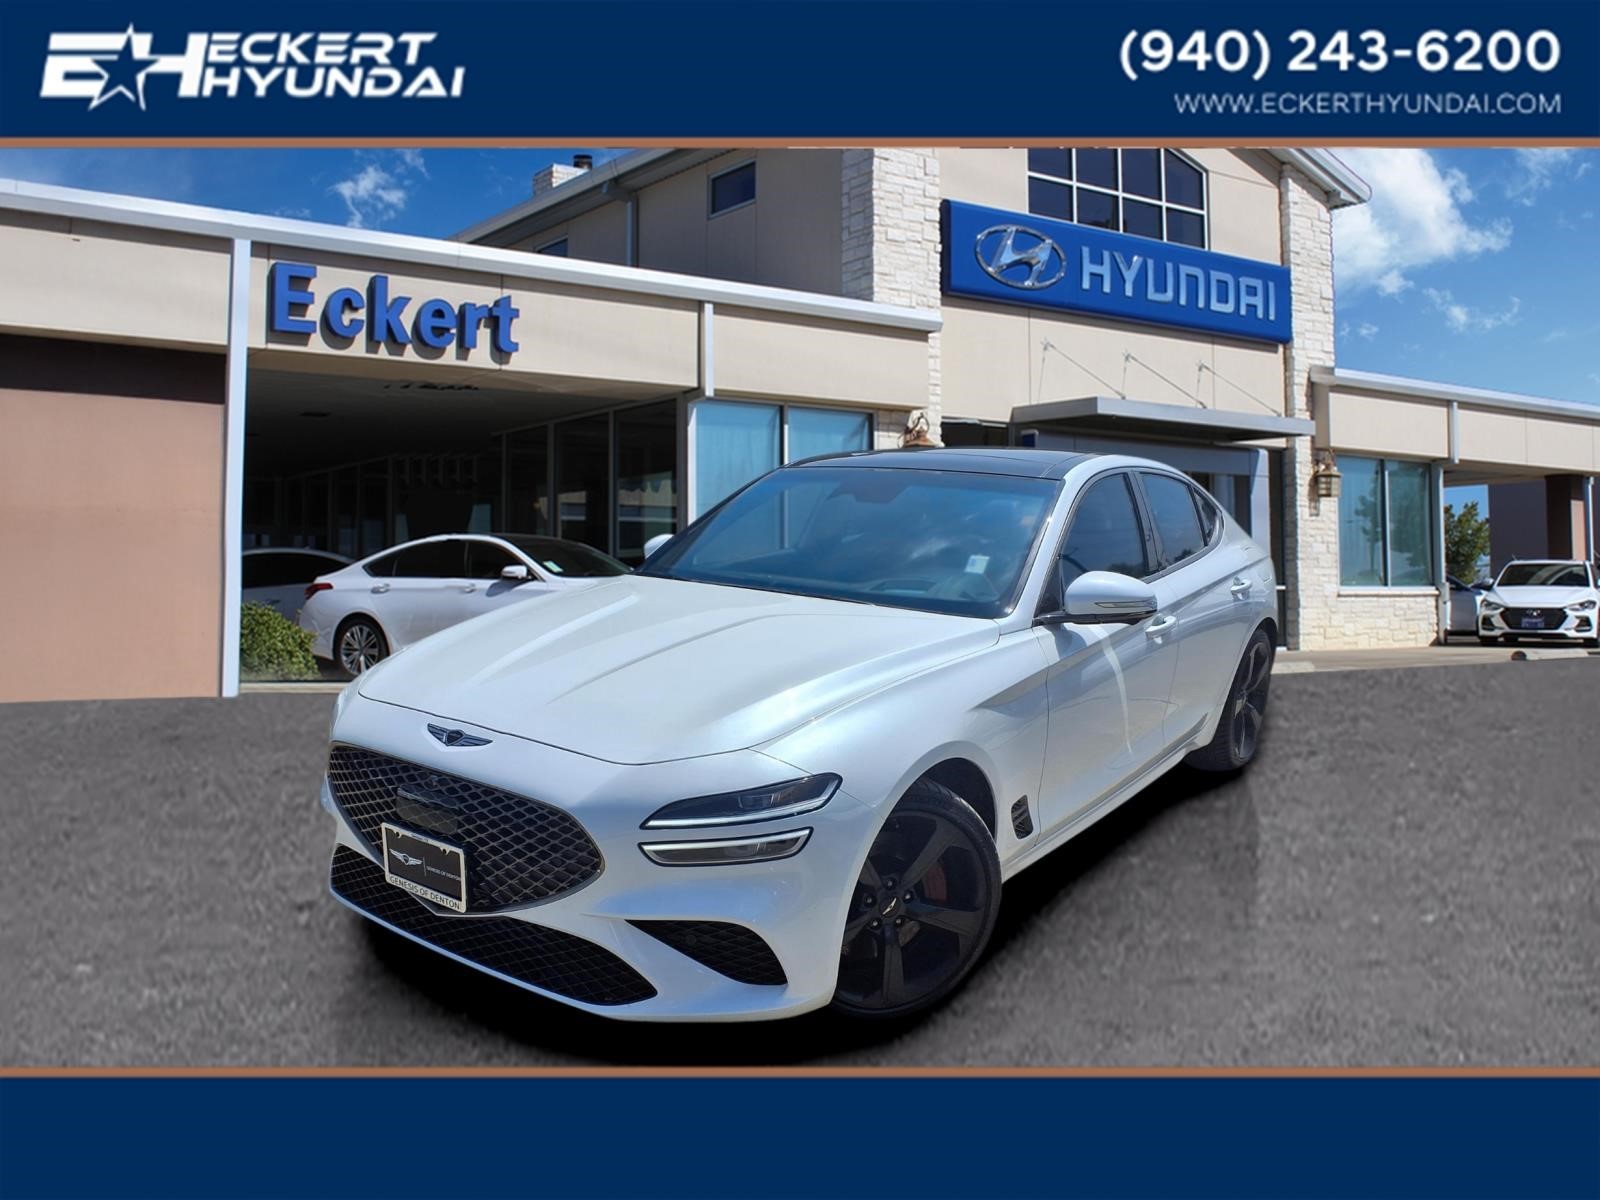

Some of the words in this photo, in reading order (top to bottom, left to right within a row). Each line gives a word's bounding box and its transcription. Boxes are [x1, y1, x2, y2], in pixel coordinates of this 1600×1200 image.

[269, 261, 520, 353] Eckert
[1081, 246, 1276, 321] HYUNDAI
[389, 875, 419, 893] GENESIS
[419, 888, 429, 899] OF
[430, 892, 460, 910] DENTON
